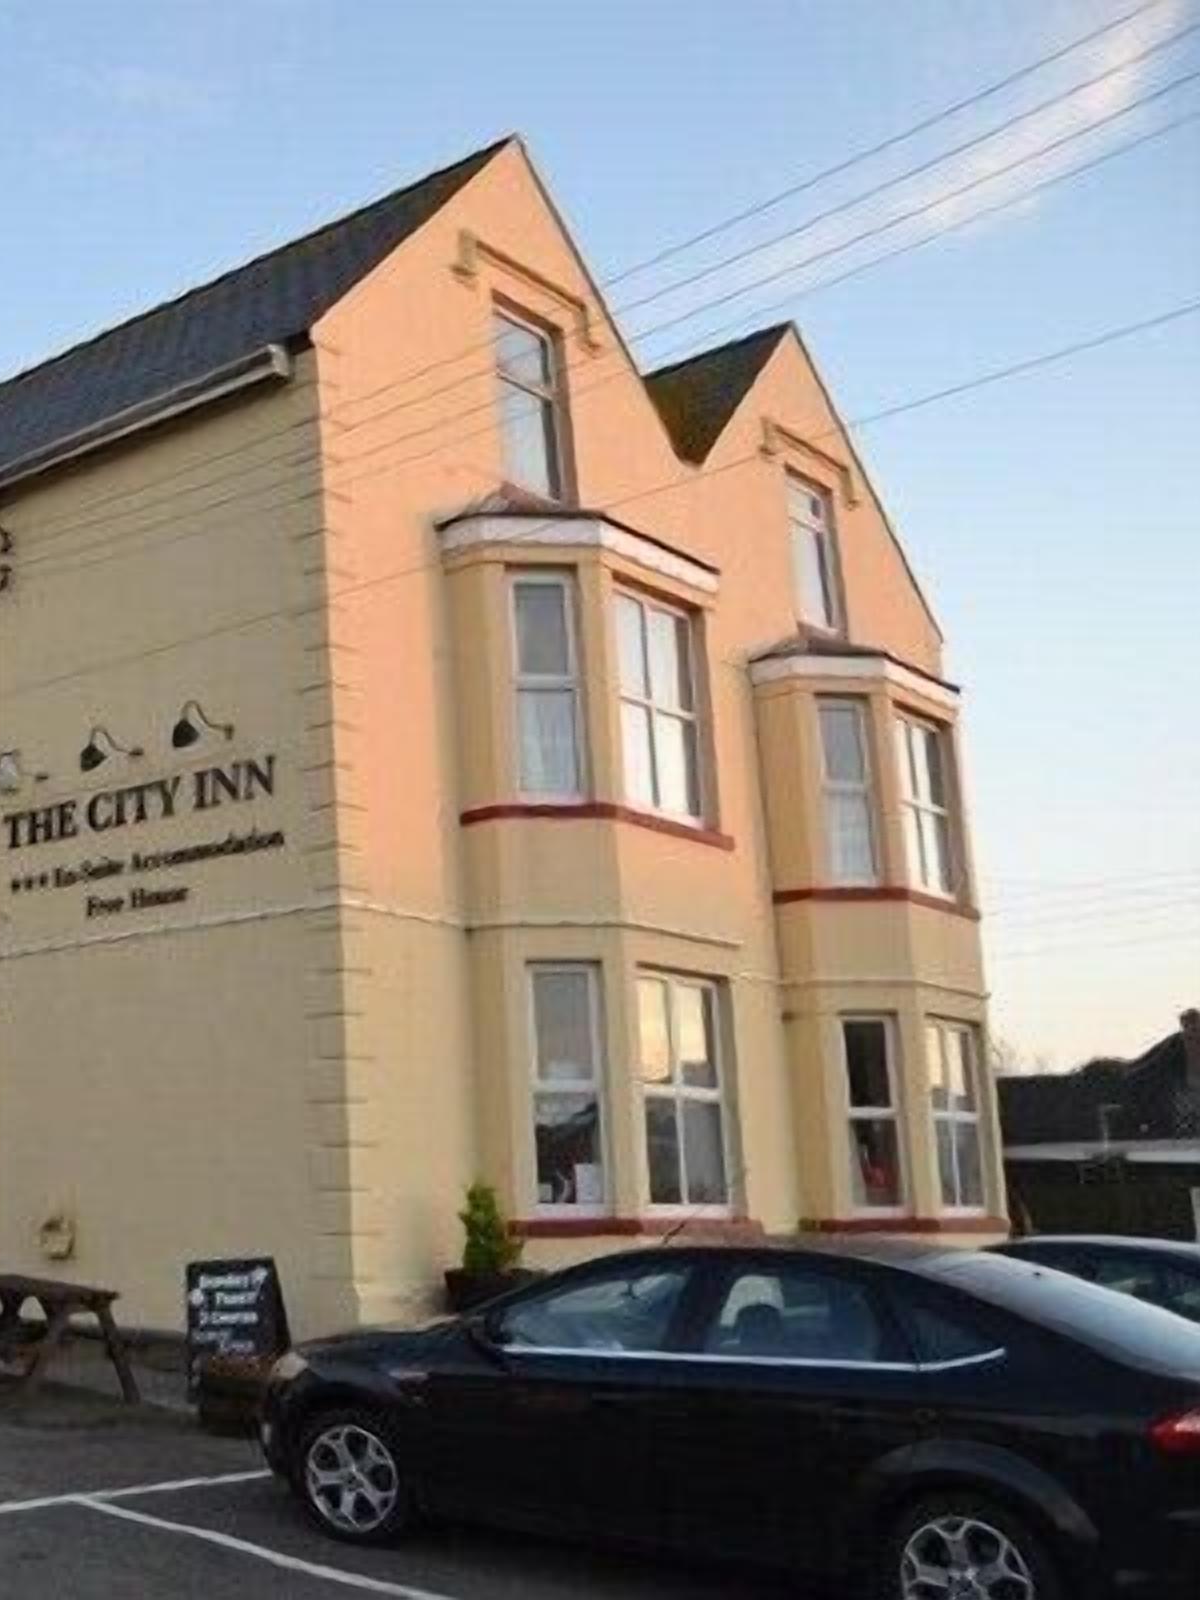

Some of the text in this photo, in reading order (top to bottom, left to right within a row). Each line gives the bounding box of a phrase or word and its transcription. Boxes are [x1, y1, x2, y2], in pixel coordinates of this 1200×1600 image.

[3, 755, 276, 849] THE CITY INN
[130, 888, 189, 909] House
